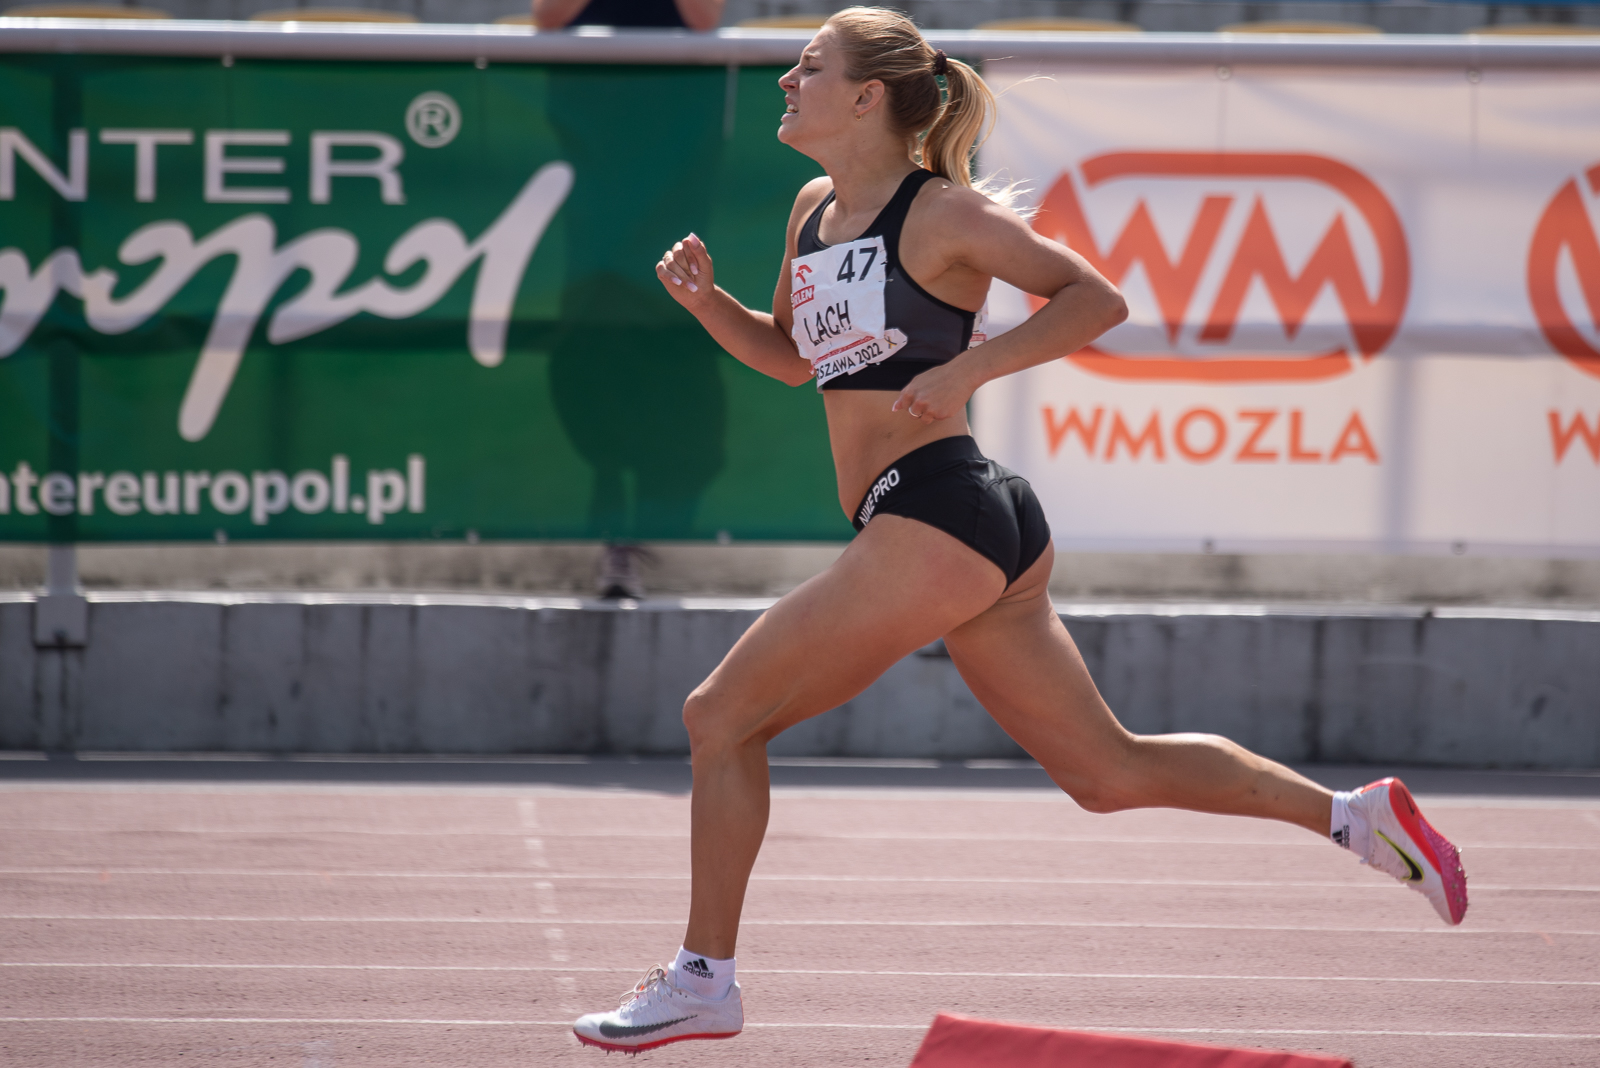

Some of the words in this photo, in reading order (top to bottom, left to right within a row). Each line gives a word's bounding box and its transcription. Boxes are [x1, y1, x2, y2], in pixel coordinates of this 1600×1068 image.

[837, 246, 878, 283] 47
[804, 300, 851, 346] LACH
[854, 342, 883, 365] 2022
[1042, 405, 1381, 464] WMOZLA
[858, 493, 875, 527] NIKE
[872, 469, 900, 503] PRO
[682, 964, 714, 979] adidas
